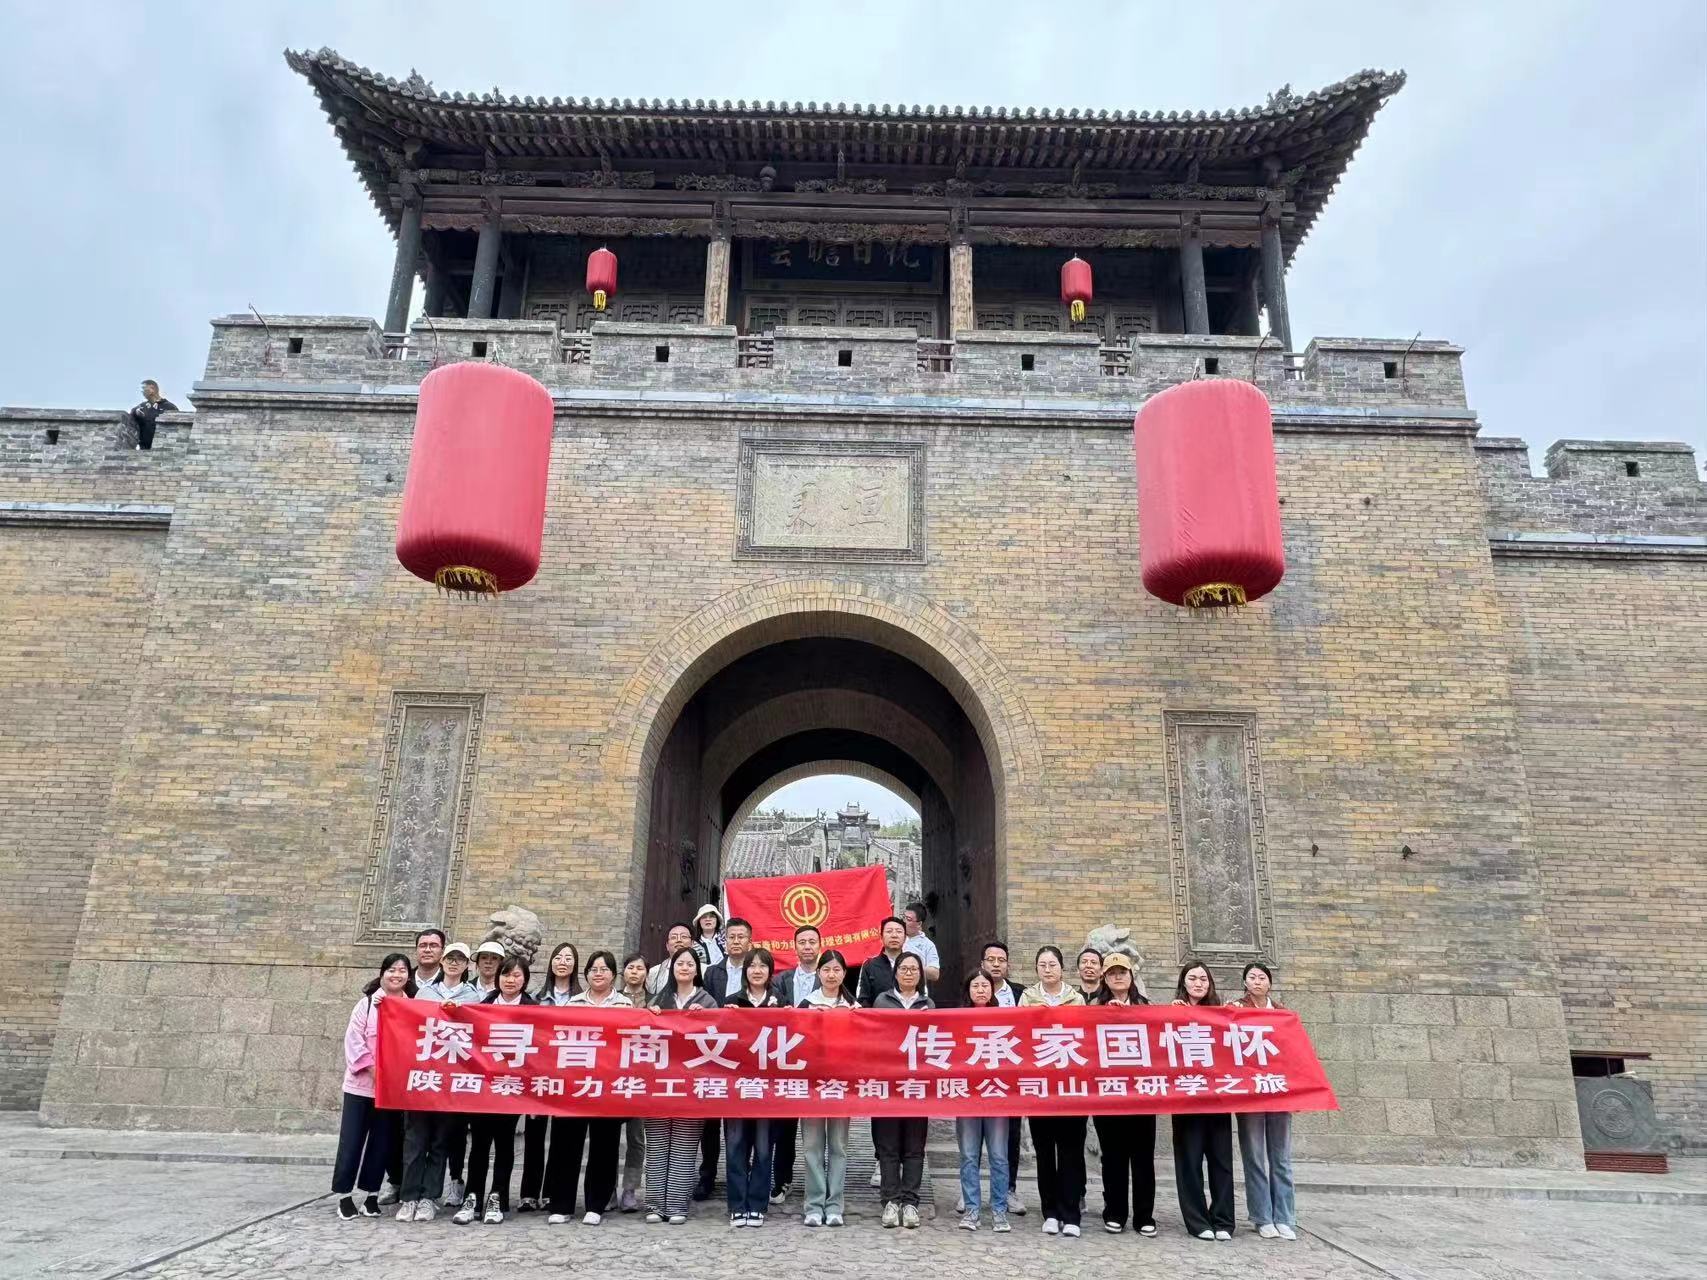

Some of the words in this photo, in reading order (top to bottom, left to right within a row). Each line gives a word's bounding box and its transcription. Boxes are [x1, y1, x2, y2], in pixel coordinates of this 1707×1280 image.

[415, 1017, 808, 1071] 探寻晋商文化
[899, 1022, 1281, 1071] 传承家国情怀
[406, 1069, 1290, 1100] 陕西泰和力华工程管理咨询有限公司山西研学之旅
